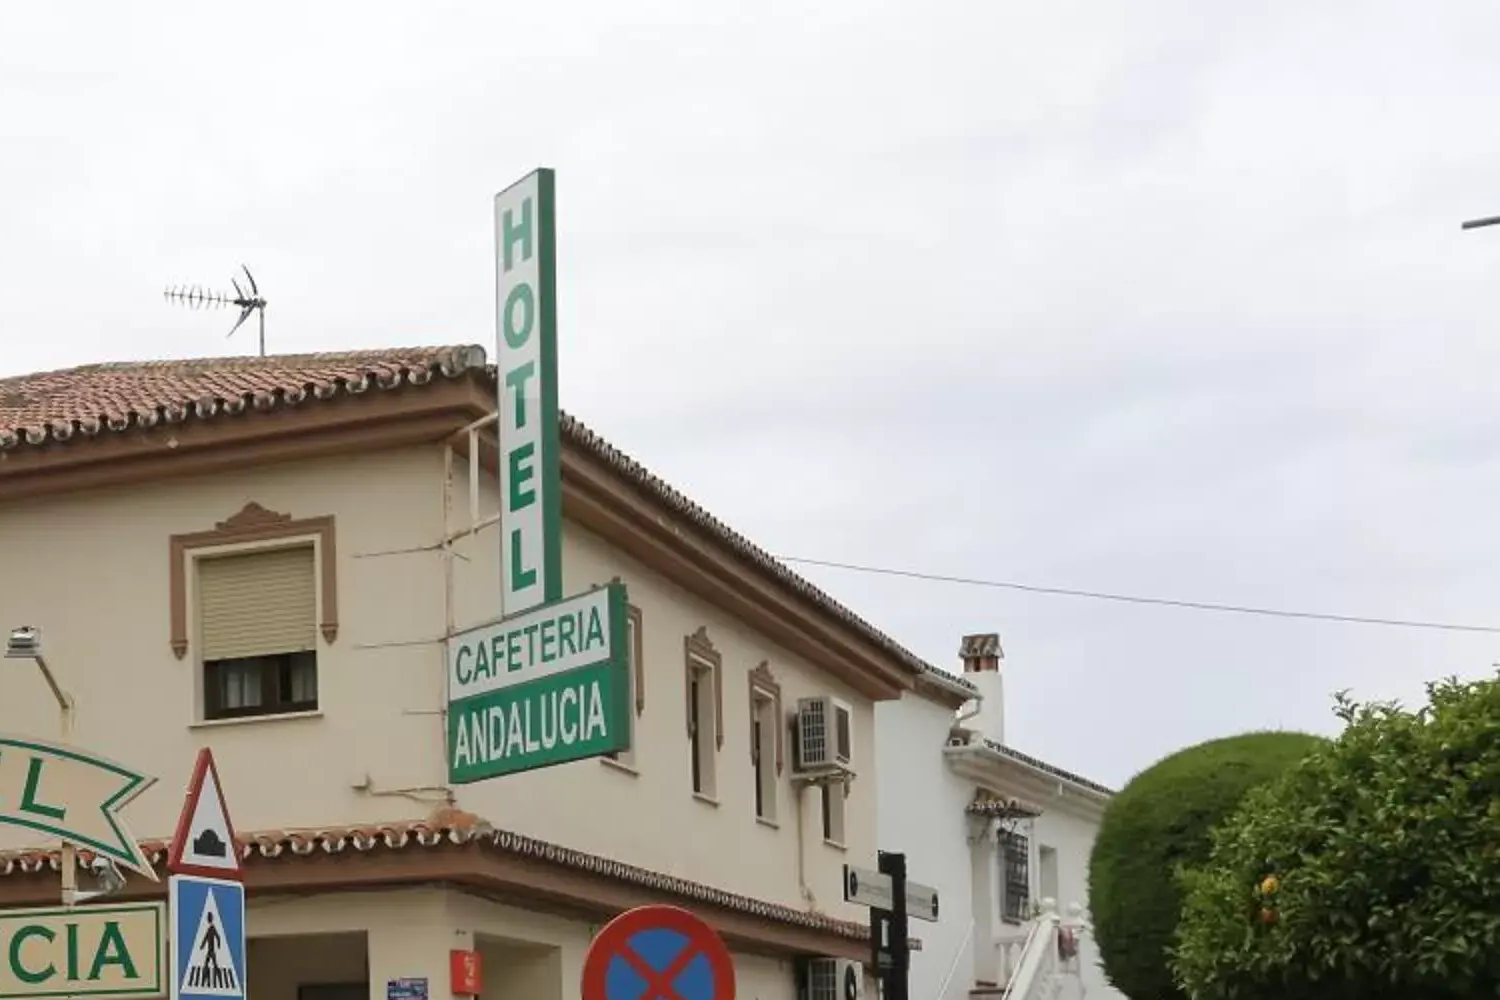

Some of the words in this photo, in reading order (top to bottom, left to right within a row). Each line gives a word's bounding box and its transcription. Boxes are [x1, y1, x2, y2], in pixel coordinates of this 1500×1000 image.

[503, 196, 536, 592] HOTEL
[456, 606, 604, 685] CAFETERIA
[454, 680, 607, 769] ANDALUCIA
